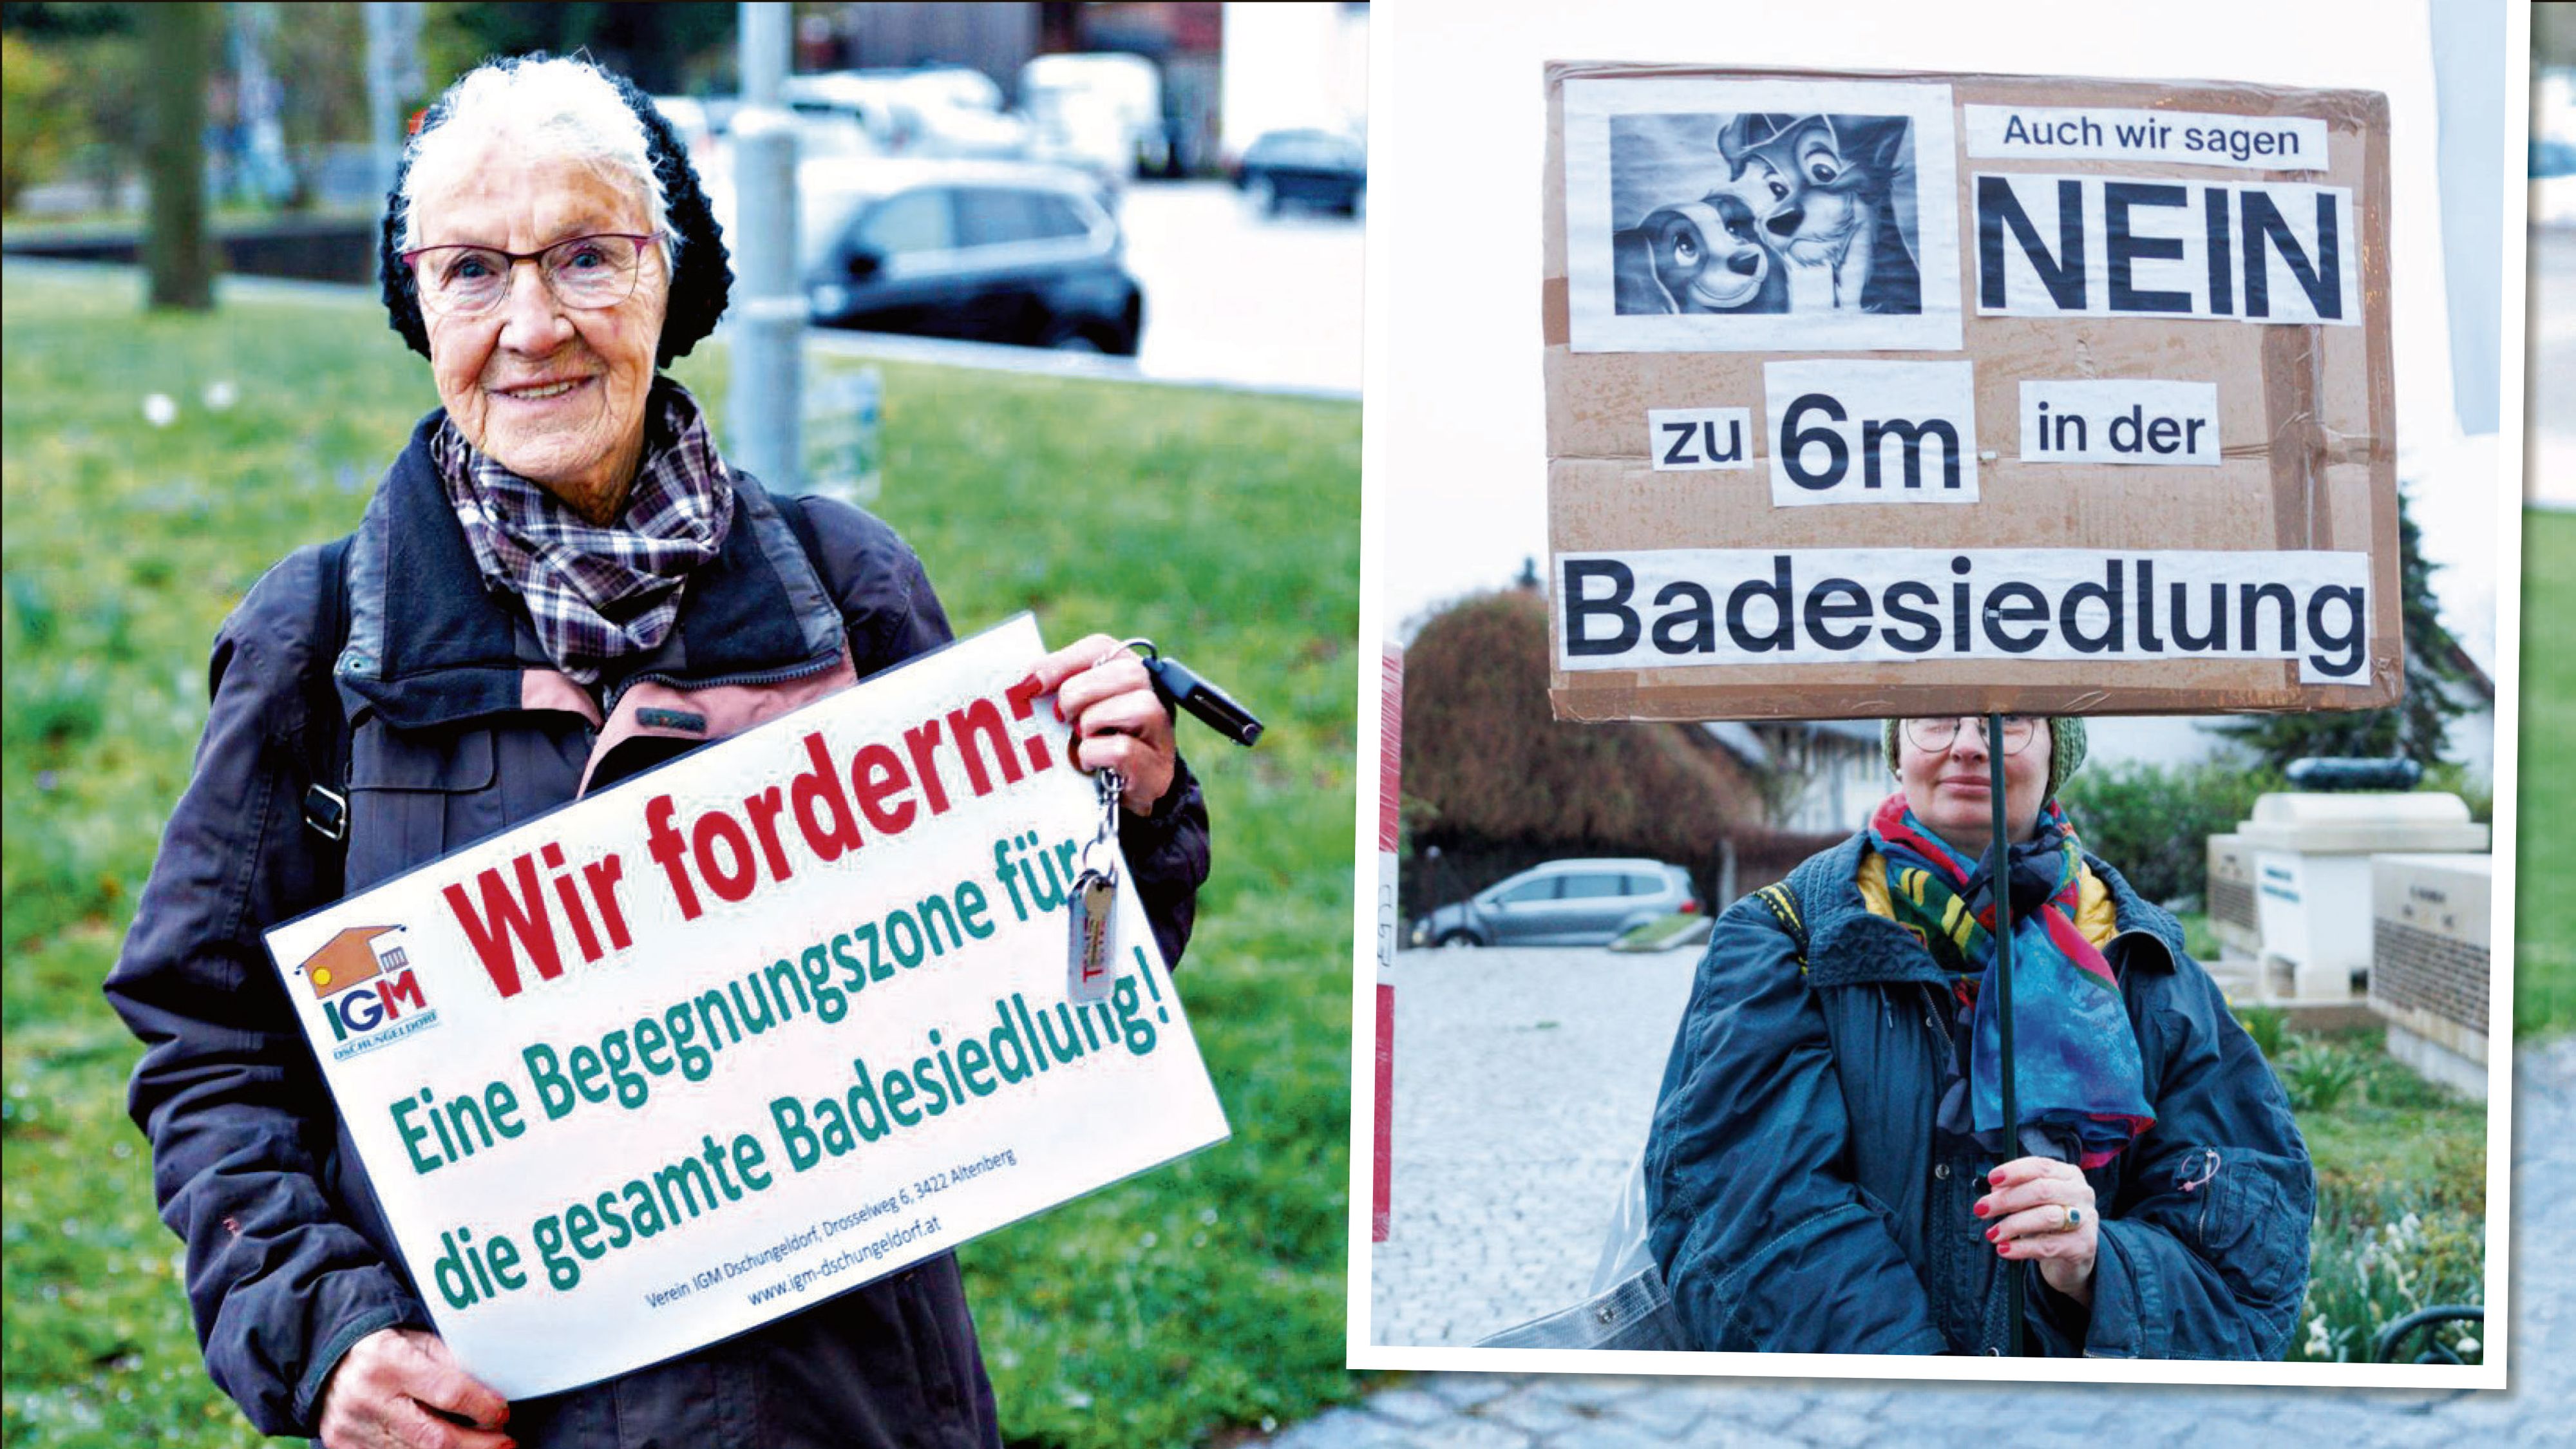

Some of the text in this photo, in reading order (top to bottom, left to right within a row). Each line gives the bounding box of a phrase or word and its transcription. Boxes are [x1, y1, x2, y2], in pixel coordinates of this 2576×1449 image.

[2003, 114, 2300, 162] Auch wir sagen
[1977, 176, 2342, 320] NEIN
[1662, 393, 2206, 490] zu 6m in der
[1564, 555, 2365, 677] Badesiedlung
[442, 685, 1053, 998] Wir fordern:
[323, 967, 427, 1041] IGM
[390, 1081, 526, 1175] Eine
[522, 880, 998, 1121] Begegnungszone
[994, 830, 1077, 922] für
[435, 1226, 527, 1310] die
[533, 1133, 773, 1291] gesamte
[770, 945, 1170, 1173] Badesiedlung!
[645, 1148, 1017, 1308] Verein IGM Dschungeldorf, Drosselweg 6, 3422 Altenberg
[746, 1215, 942, 1306] www.igm-dschungeldorf.at
